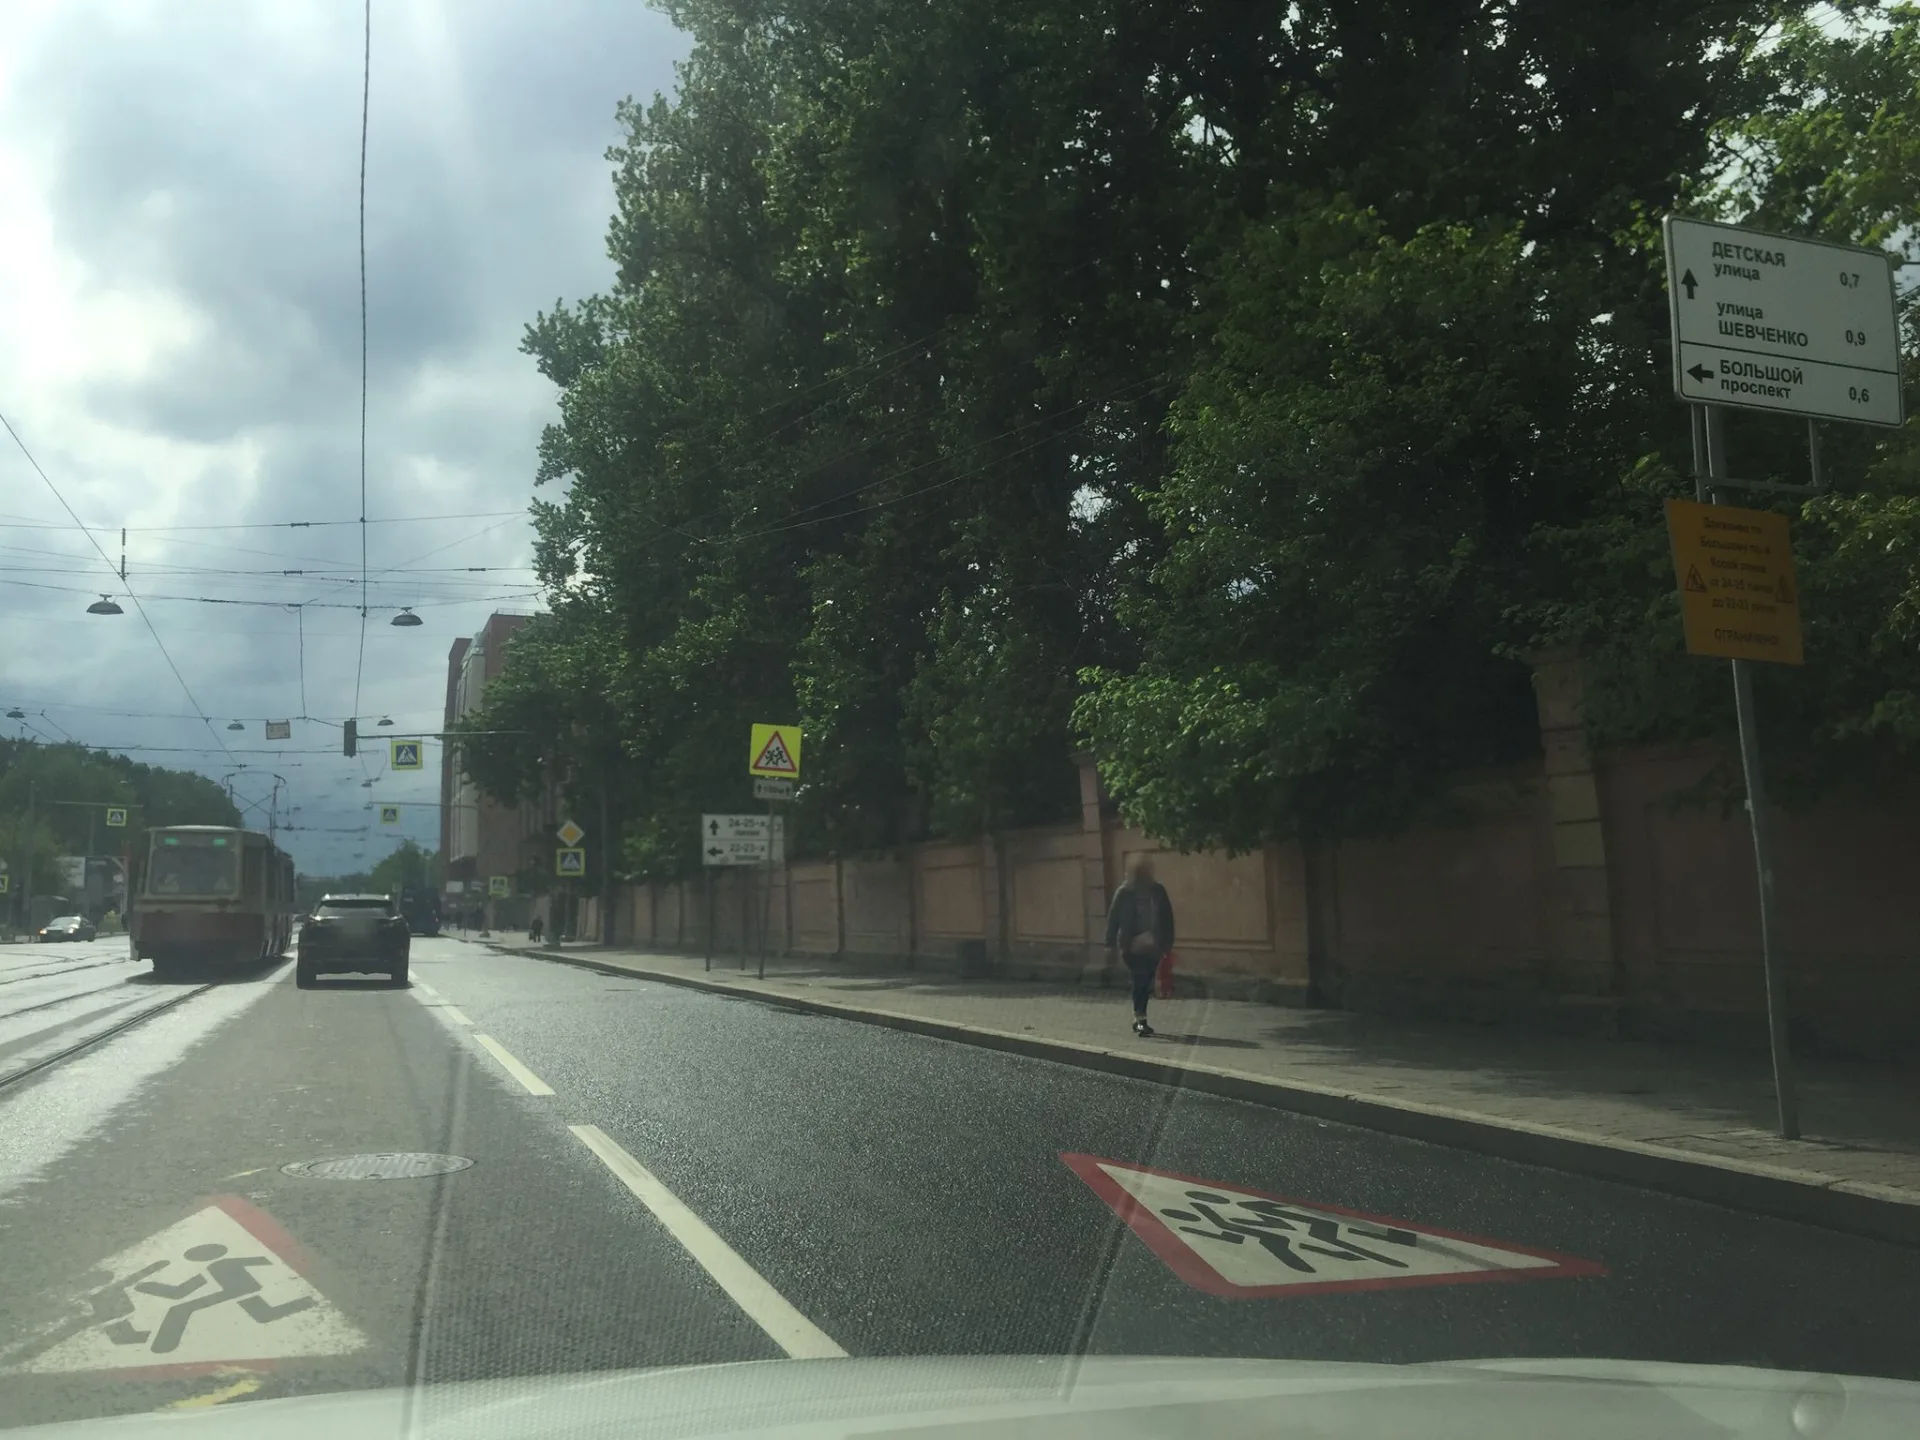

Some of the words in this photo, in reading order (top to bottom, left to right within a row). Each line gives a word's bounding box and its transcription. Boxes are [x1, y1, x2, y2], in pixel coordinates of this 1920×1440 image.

[1712, 241, 1786, 267] ДЕТСКАЯ
[1713, 263, 1760, 281] улица
[1717, 302, 1763, 320] улица
[1719, 320, 1808, 347] ШЕВЧЕНКО
[1846, 330, 1866, 347] 0,9
[1720, 359, 1803, 385] БОЛЬШОЙ
[1721, 378, 1791, 400] проспект
[1849, 386, 1870, 404] 0,6
